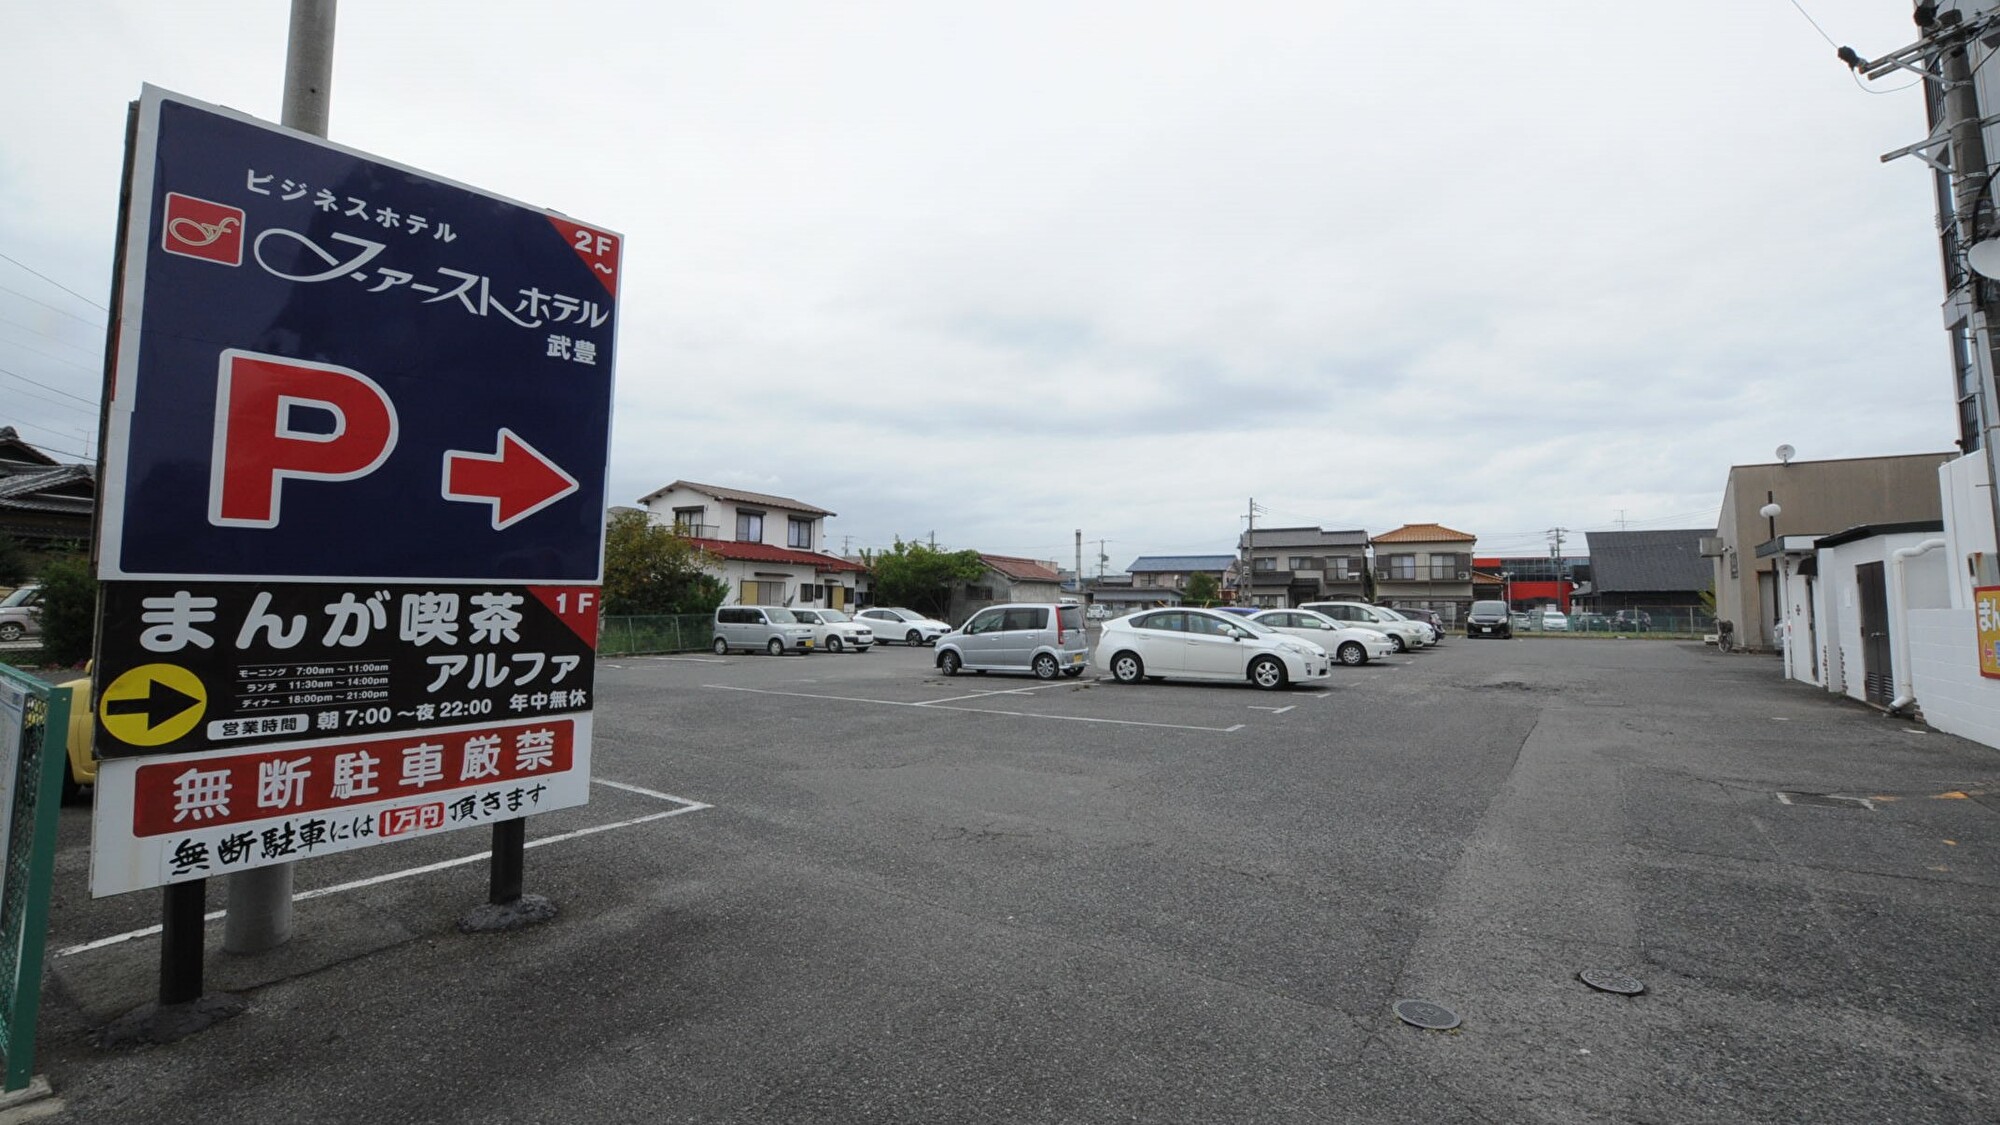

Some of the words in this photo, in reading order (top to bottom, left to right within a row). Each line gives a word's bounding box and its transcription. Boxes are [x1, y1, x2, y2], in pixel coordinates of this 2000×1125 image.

[246, 168, 458, 244] ビジネスホテル
[574, 230, 612, 256] 2F
[547, 334, 597, 365] 武豊
[208, 348, 399, 529] P
[140, 590, 525, 652] まんが喫茶
[556, 593, 594, 615] 1F
[239, 668, 287, 678] モーニング
[246, 683, 277, 693] ランチ
[426, 652, 582, 693] アルファ
[222, 718, 298, 737] 営業時間
[509, 689, 587, 712] 年中無休
[242, 699, 280, 708] ディナー
[172, 728, 556, 824] 無断駐車厳禁
